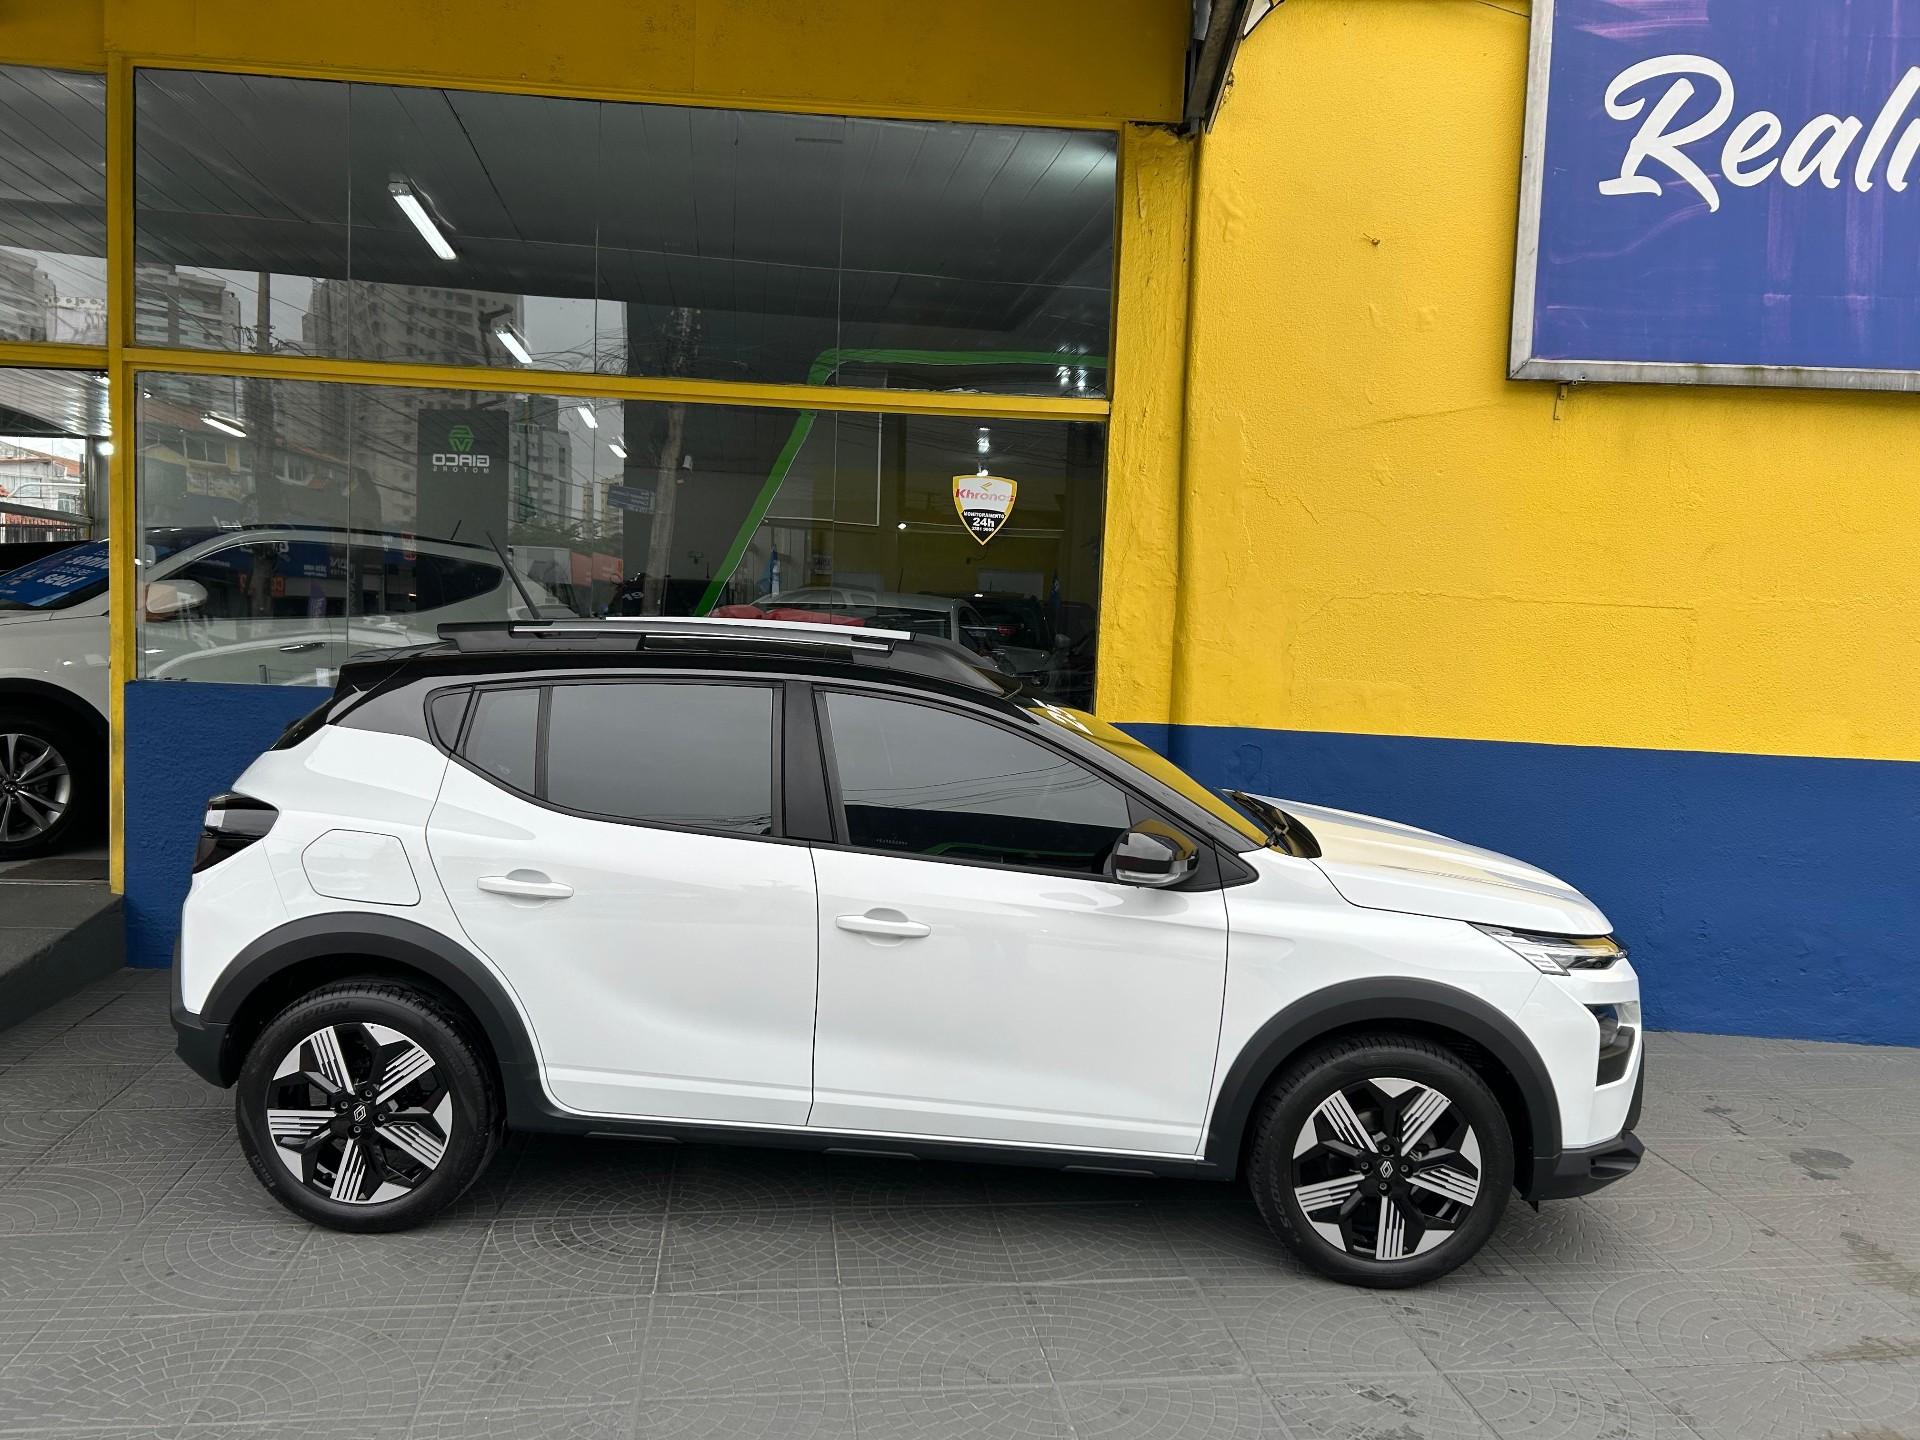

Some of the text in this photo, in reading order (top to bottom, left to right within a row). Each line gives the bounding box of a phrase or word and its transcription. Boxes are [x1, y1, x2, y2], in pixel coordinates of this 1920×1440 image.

[955, 488, 1015, 502] Khronos
[963, 511, 1005, 519] MONITORAMENTO
[972, 517, 995, 527] 24h
